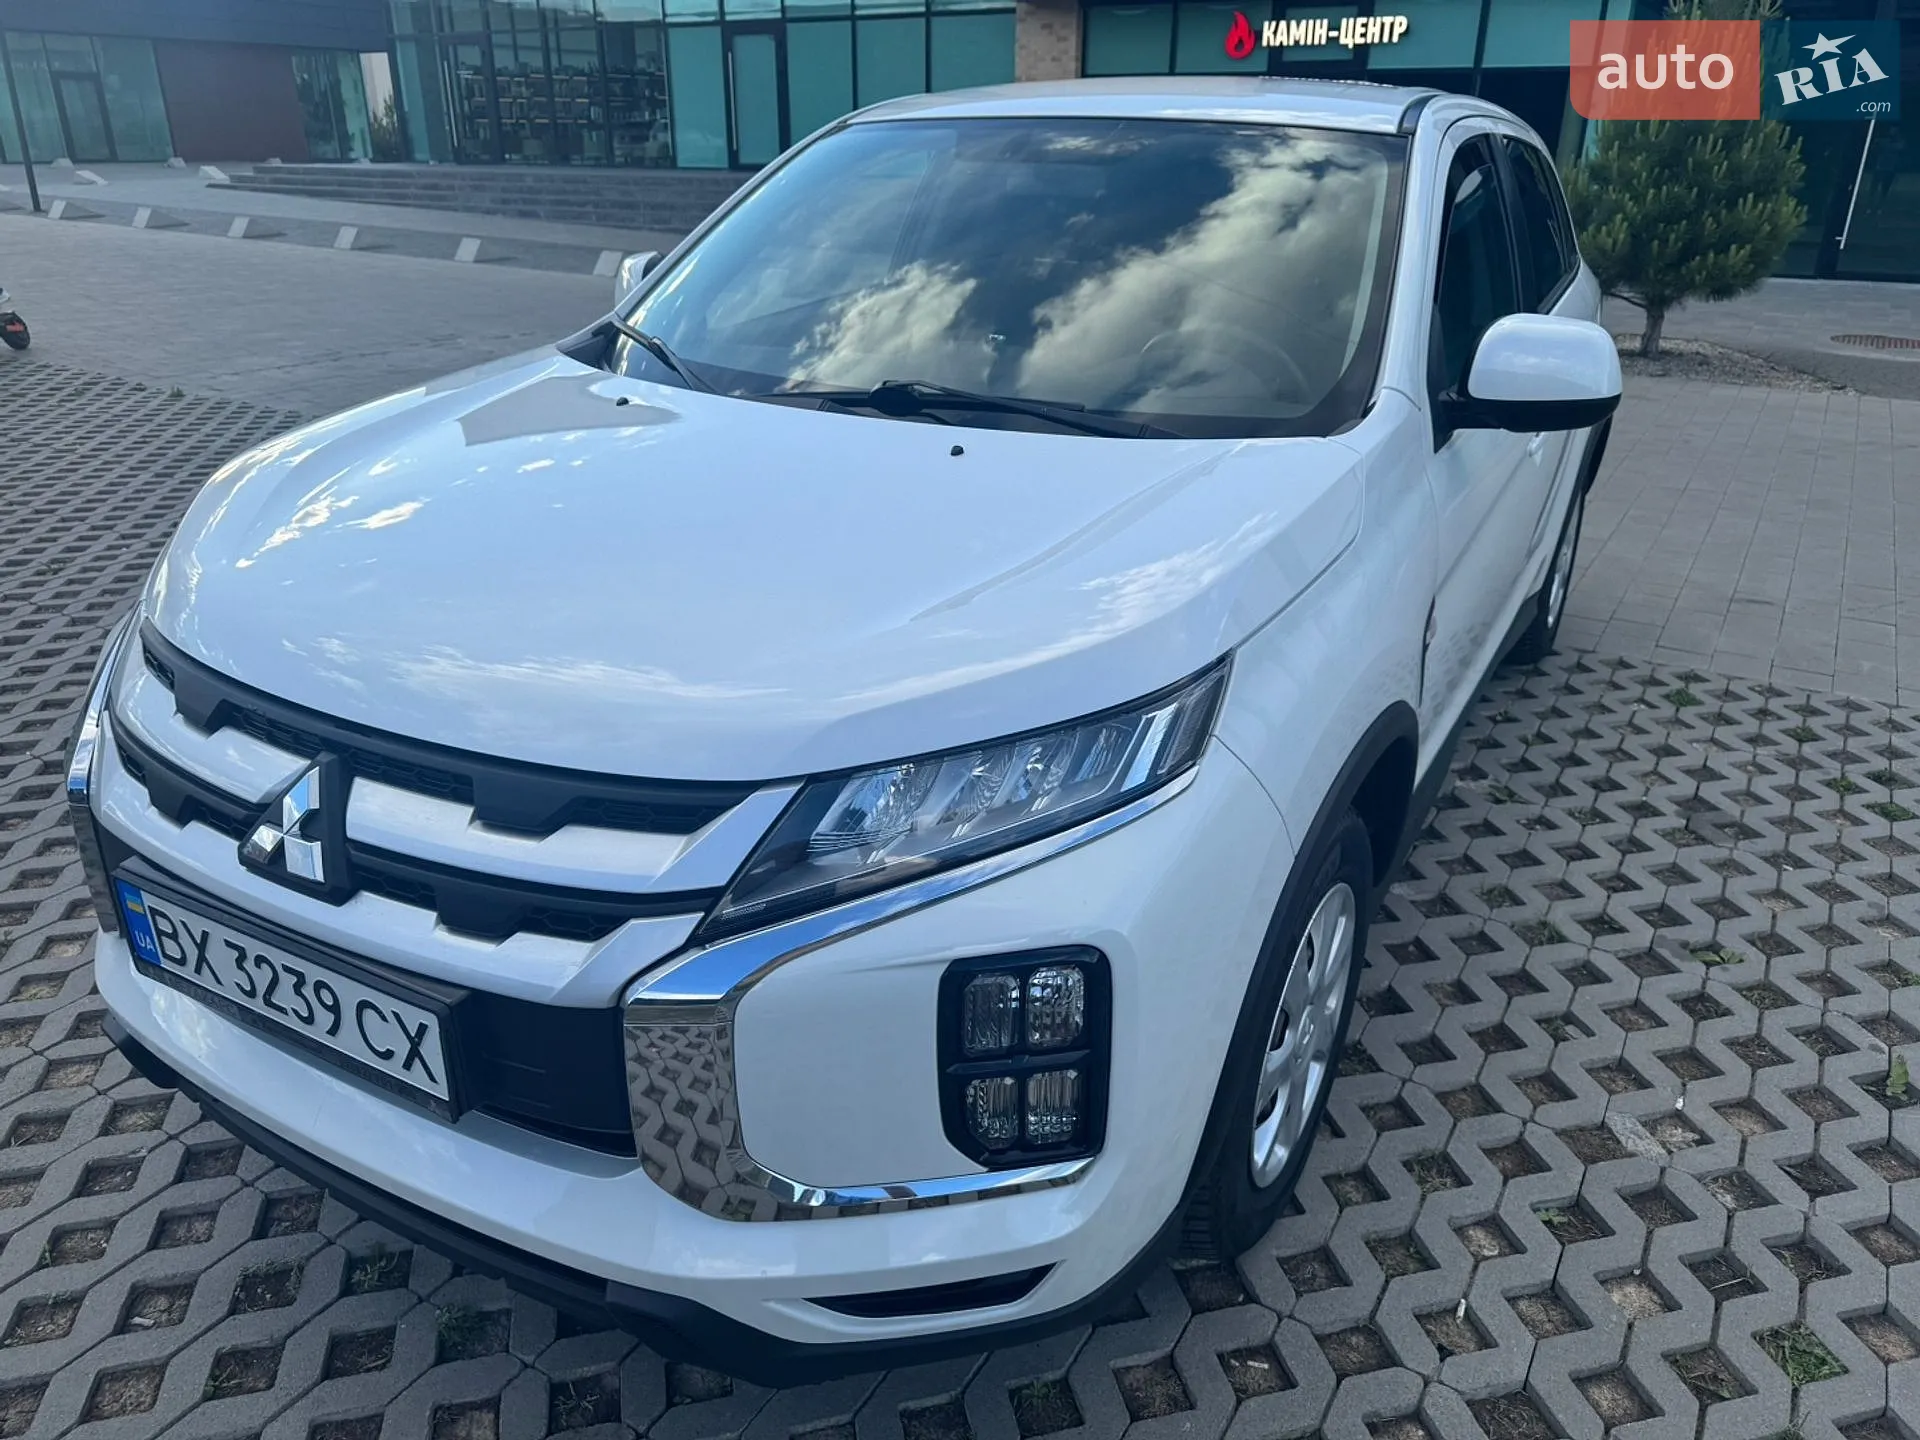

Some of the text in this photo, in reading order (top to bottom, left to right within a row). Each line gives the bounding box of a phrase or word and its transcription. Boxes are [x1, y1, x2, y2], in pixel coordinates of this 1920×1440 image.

[1261, 15, 1408, 49] КАМІН-ЦЕНТР
[134, 930, 156, 953] UA
[147, 904, 224, 987] BX
[223, 937, 341, 1037] 3239
[356, 998, 438, 1084] CX
